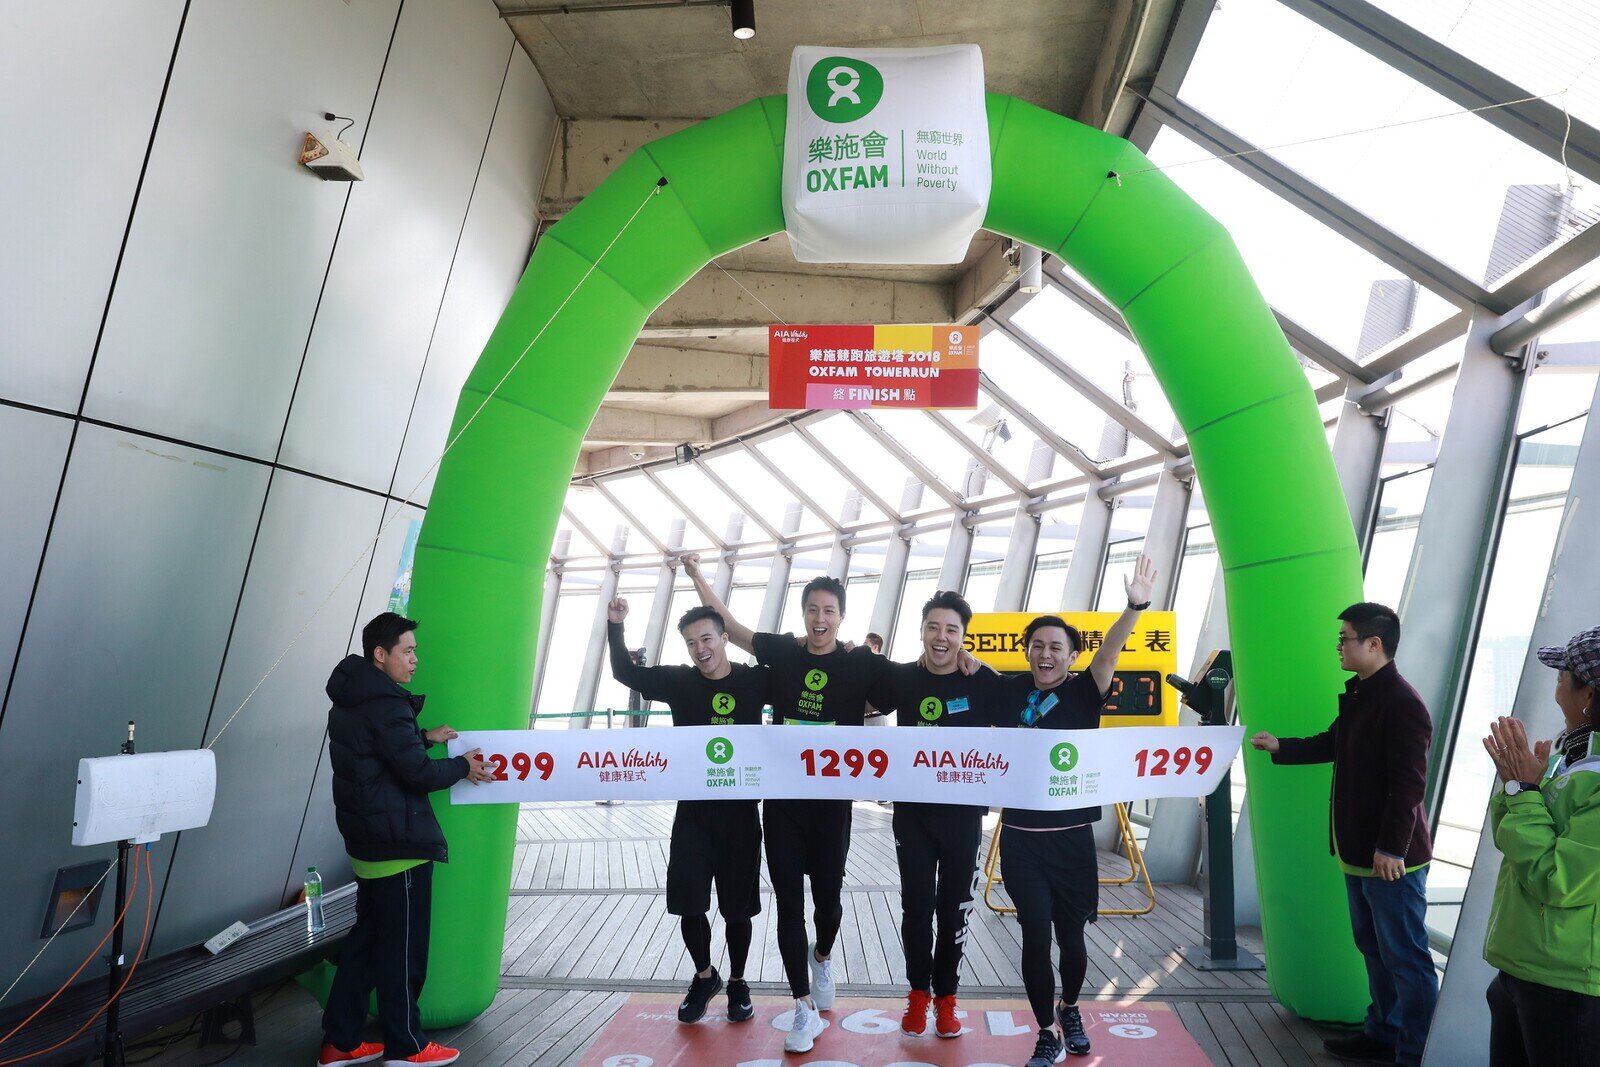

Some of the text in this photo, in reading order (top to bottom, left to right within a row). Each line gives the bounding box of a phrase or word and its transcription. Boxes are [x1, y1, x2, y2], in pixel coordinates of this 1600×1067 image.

[916, 130, 964, 147] 無窮世界
[808, 130, 889, 163] 樂施會
[917, 150, 948, 161] World
[917, 163, 959, 175] Without
[806, 165, 889, 193] OXFAM
[917, 177, 958, 192] Poverty
[774, 330, 790, 338] AIA
[809, 349, 941, 363] 樂施競跑旅遊塔 2018
[809, 366, 940, 378] OXFAM TOWERRUN
[833, 387, 845, 401] 終
[849, 388, 900, 401] FINISH
[963, 633, 1028, 652] SEIK
[798, 699, 822, 711] OXFAM
[577, 747, 669, 773] AIA Vitality
[800, 748, 889, 779] 1299
[913, 748, 1010, 777] AIA Vitality
[1134, 745, 1214, 777] 1299
[599, 770, 647, 783] 健康程式
[706, 778, 736, 788] OXFAM
[936, 770, 987, 785] 健康程式
[1049, 774, 1079, 786] 樂施會
[1048, 786, 1078, 797] OXFAM
